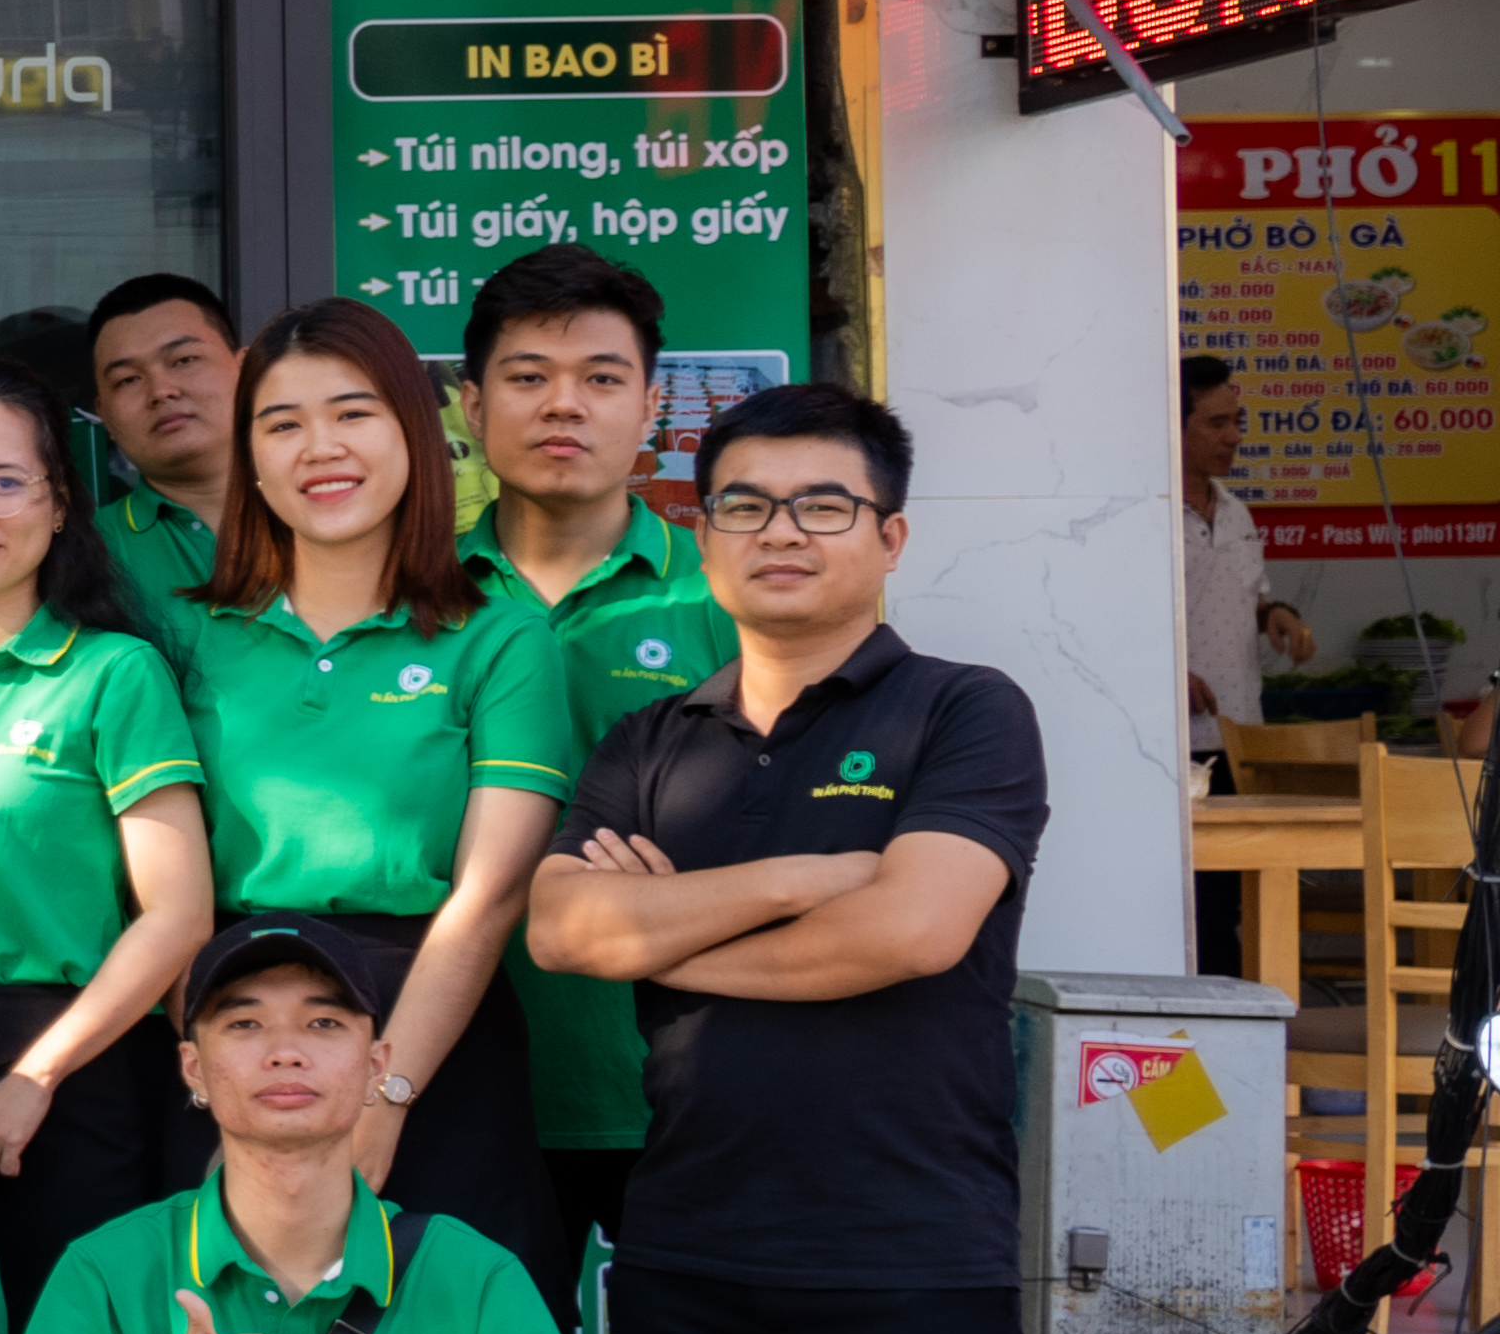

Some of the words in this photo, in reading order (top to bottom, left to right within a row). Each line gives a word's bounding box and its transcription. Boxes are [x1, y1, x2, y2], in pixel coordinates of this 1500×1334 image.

[467, 45, 510, 79] IN
[525, 43, 616, 78] BAO
[631, 33, 669, 76] BÌ
[394, 134, 455, 171] Túi
[472, 136, 620, 178] nilong,
[635, 130, 688, 167] túi
[703, 125, 788, 174] xốp
[1237, 124, 1418, 199] PHỞ
[397, 200, 456, 238] Túi
[472, 193, 576, 247] giấy,
[594, 199, 678, 245] hộp
[692, 191, 788, 244] giấy
[1178, 217, 1252, 250] PHỞ
[1266, 217, 1317, 250] BÒ
[1350, 216, 1404, 248] GÀ
[398, 268, 458, 304] Túi
[1259, 401, 1320, 433] THỐ
[1394, 408, 1493, 432] 60.000
